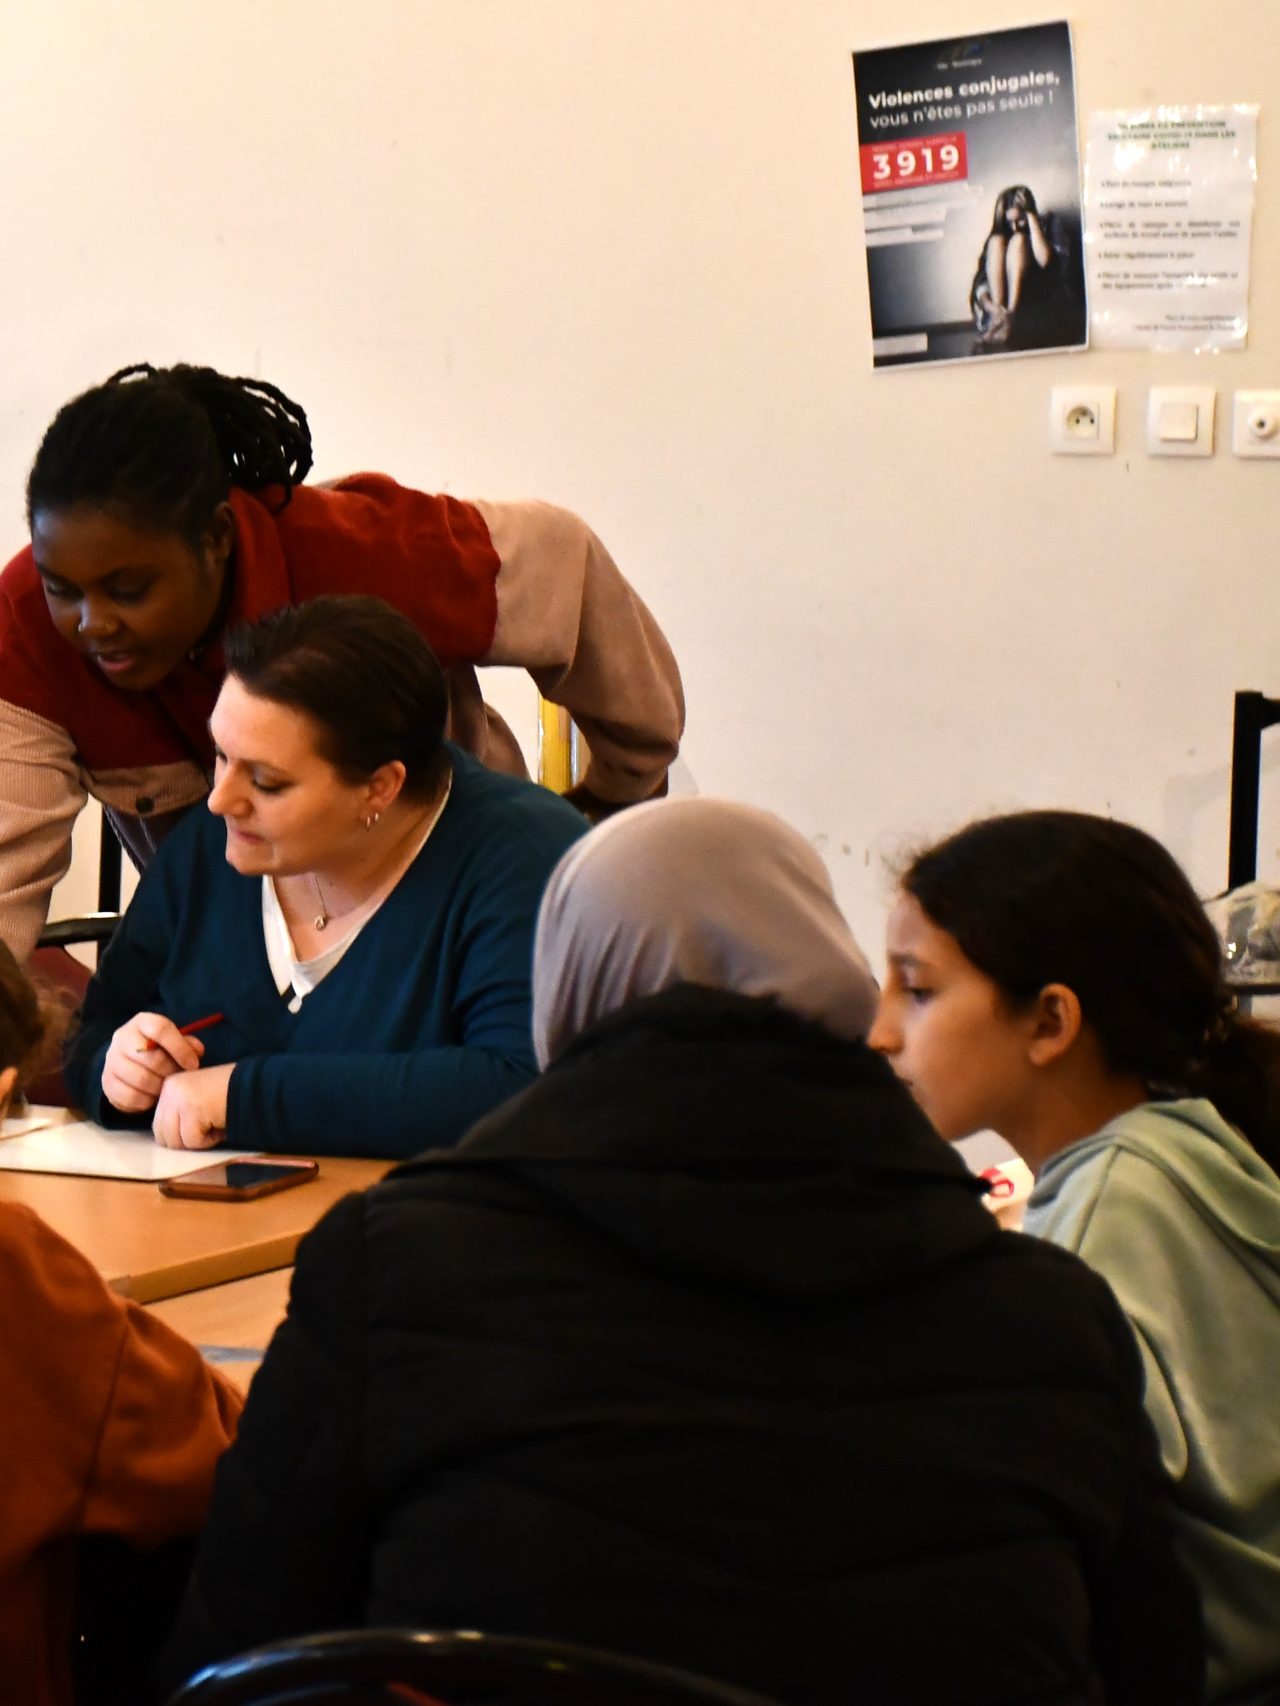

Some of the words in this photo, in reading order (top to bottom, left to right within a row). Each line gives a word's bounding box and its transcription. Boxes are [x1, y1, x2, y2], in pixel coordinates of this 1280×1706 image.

[869, 87, 953, 109] Violences
[959, 70, 1060, 96] conjugales,
[870, 111, 909, 128] vous
[913, 104, 962, 123] n'êtes
[966, 100, 995, 118] pas
[1000, 91, 1044, 111] seule
[872, 144, 960, 180] 3919
